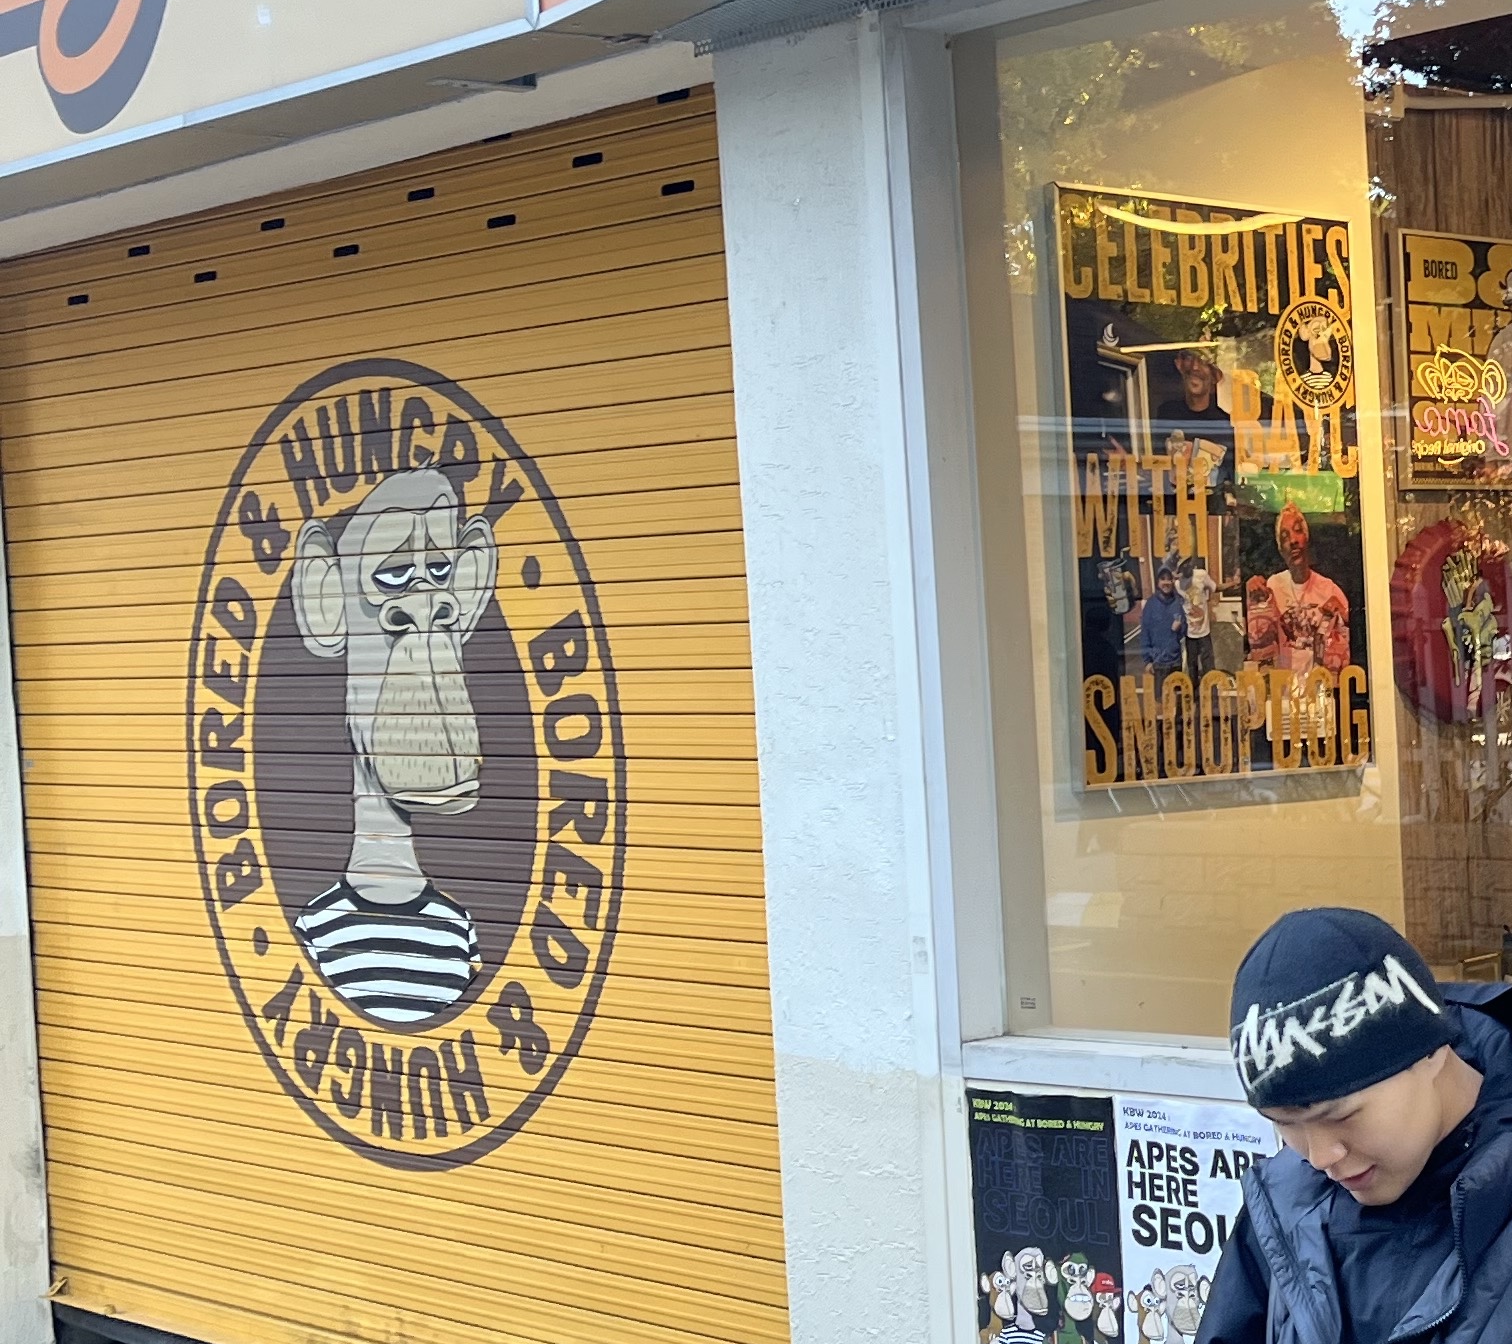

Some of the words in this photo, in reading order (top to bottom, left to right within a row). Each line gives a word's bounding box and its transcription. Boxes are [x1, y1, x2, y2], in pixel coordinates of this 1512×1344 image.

[1060, 193, 1350, 323] CELEBRITIES
[1423, 259, 1458, 280] BORED
[1281, 328, 1294, 376] BORED
[1338, 335, 1350, 382] BORED
[1073, 453, 1207, 558] WITH
[200, 577, 263, 912] BORED
[239, 490, 292, 575] &
[524, 610, 608, 990] BORED
[261, 963, 490, 1141] HUNGRY
[489, 982, 550, 1076] &
[1126, 1140, 1199, 1177] APES
[1127, 1170, 1199, 1208] HERE
